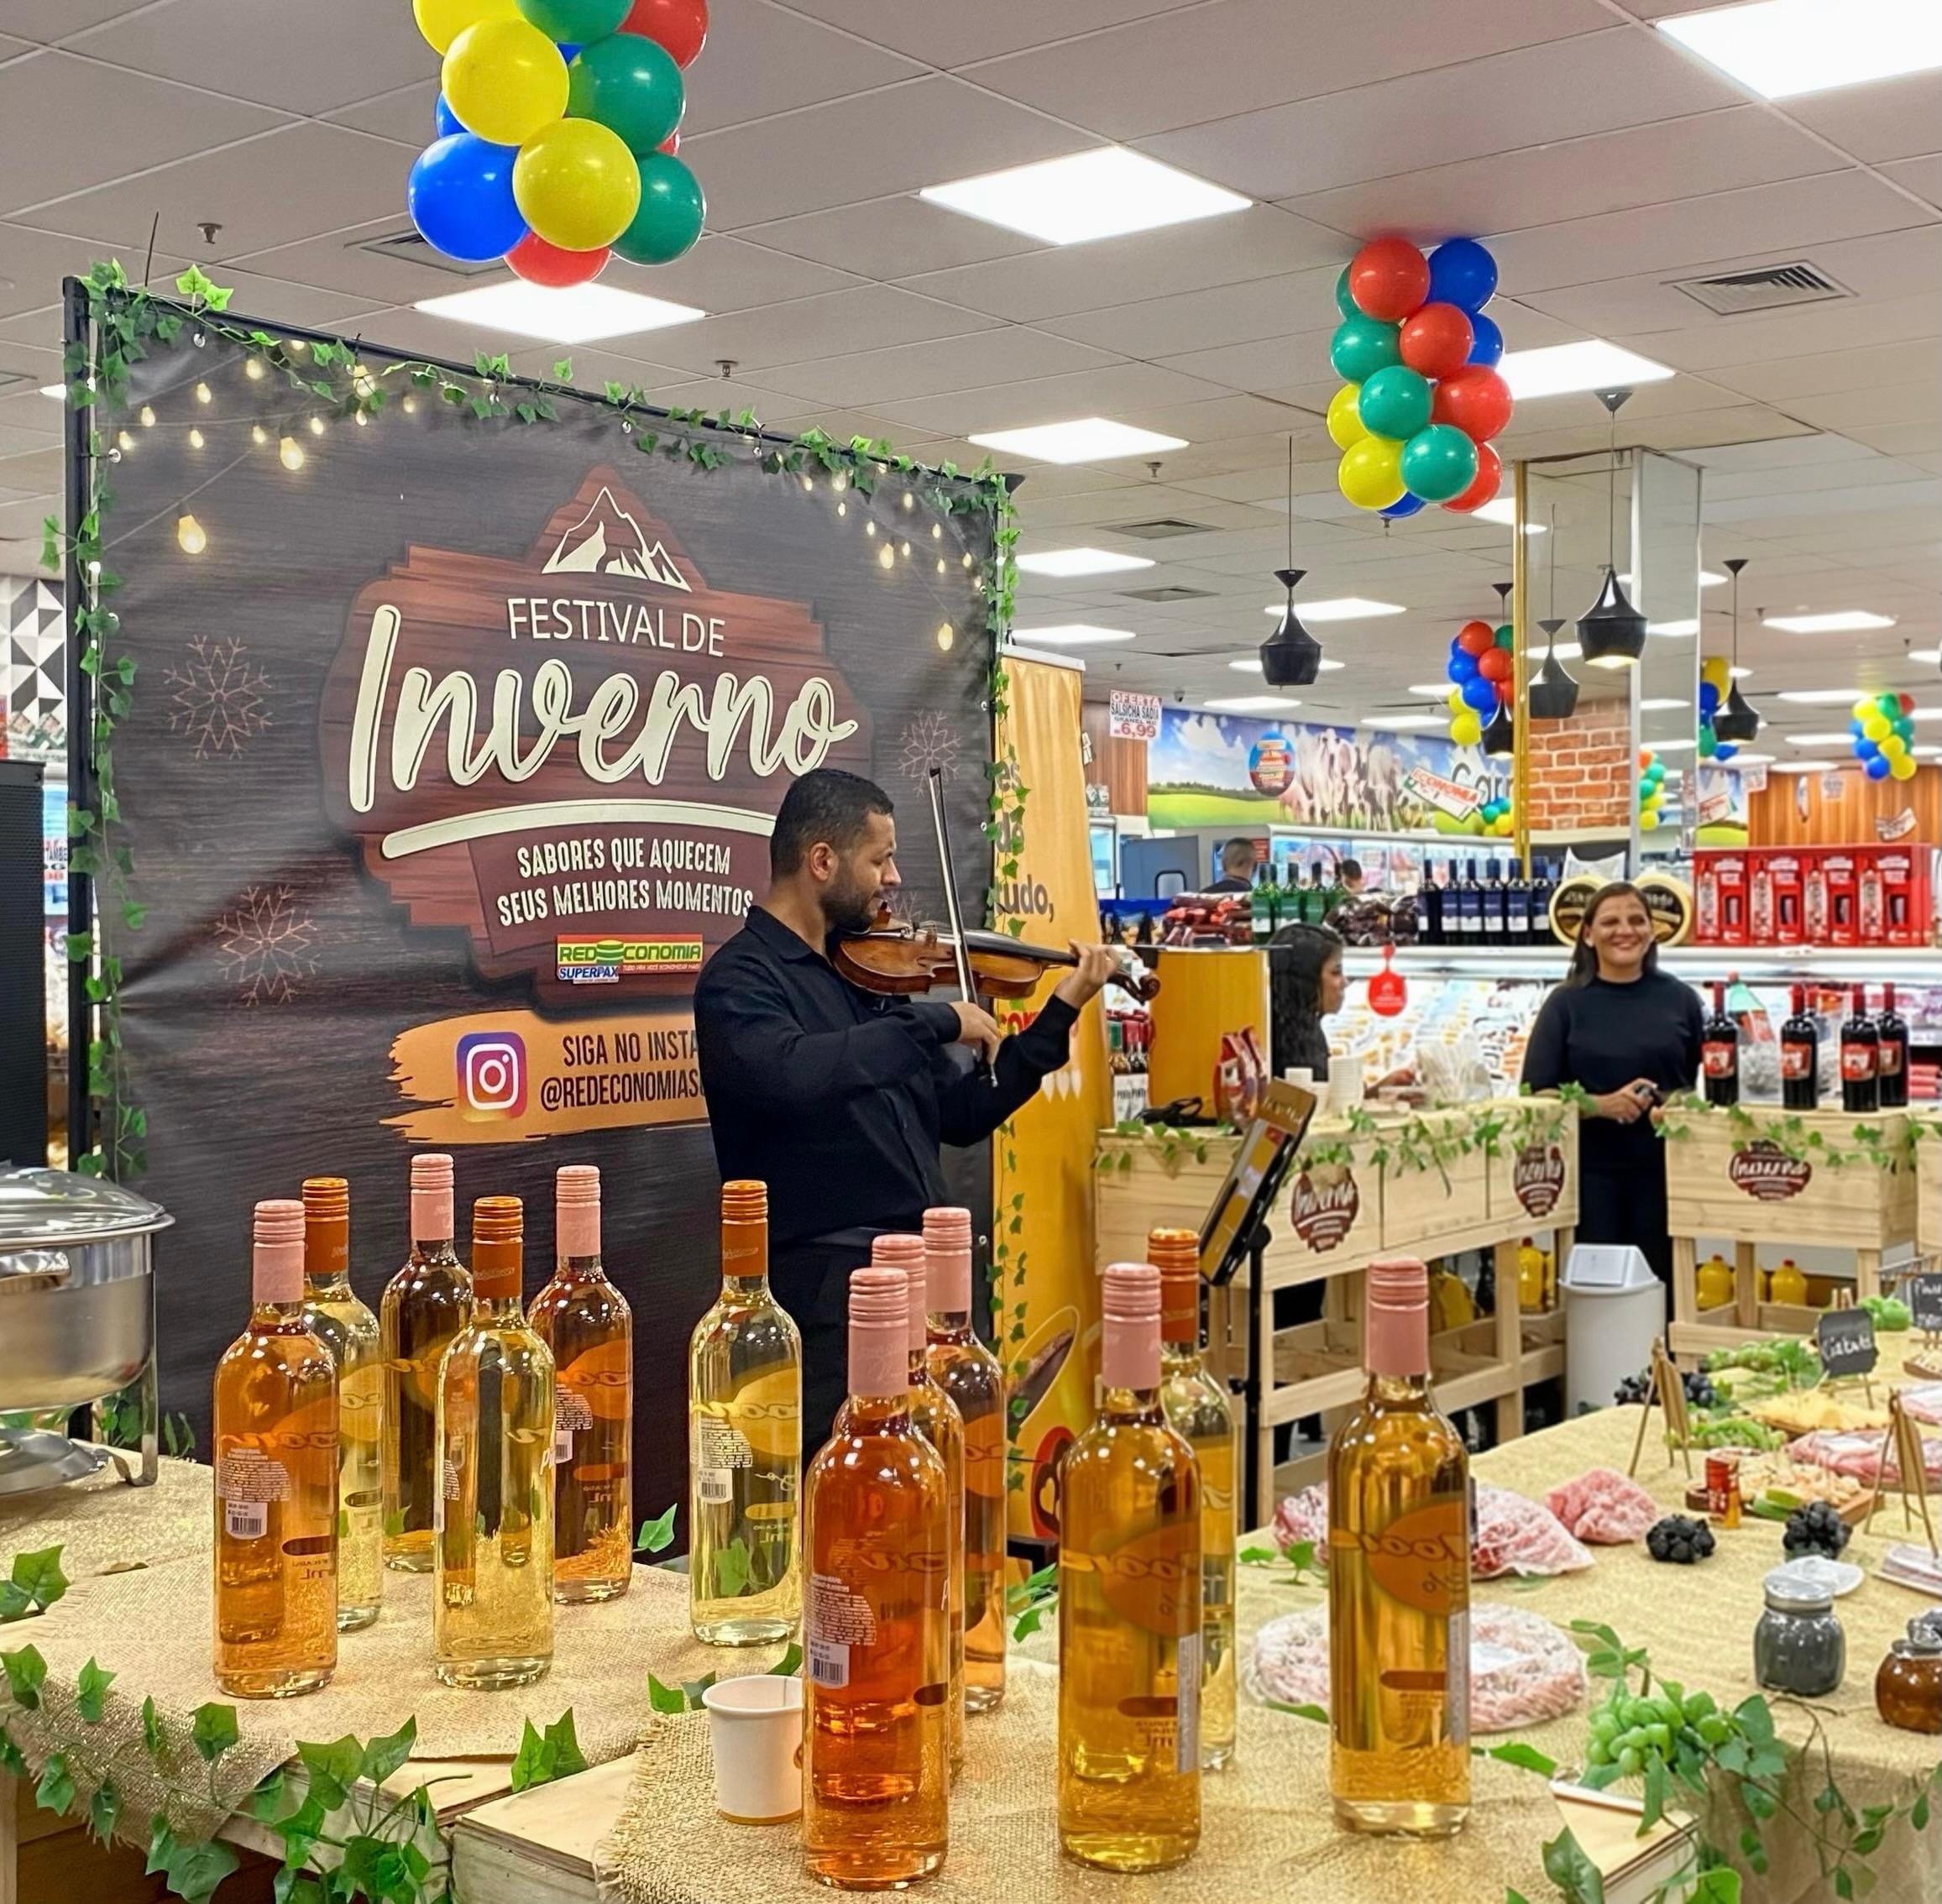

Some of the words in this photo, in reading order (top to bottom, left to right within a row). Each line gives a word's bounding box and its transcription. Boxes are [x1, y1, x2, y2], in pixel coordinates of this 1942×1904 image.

[507, 598, 675, 649] FESTIVAL
[683, 613, 725, 657] DE
[348, 604, 858, 813] Inverno
[1112, 692, 1161, 707] OFERTA
[1121, 722, 1156, 738] 6,99
[517, 838, 605, 878] SABORES
[610, 838, 644, 873] QUE
[650, 839, 730, 875] AQUECEM
[497, 888, 547, 926] SEUS
[552, 880, 649, 916] MELHORES
[657, 880, 753, 918] MOMENTOS
[560, 966, 619, 978] SUPERPAX
[563, 1034, 608, 1067] SIGA
[615, 1032, 641, 1064] NO
[541, 1069, 705, 1112] @REDECONOMIAS
